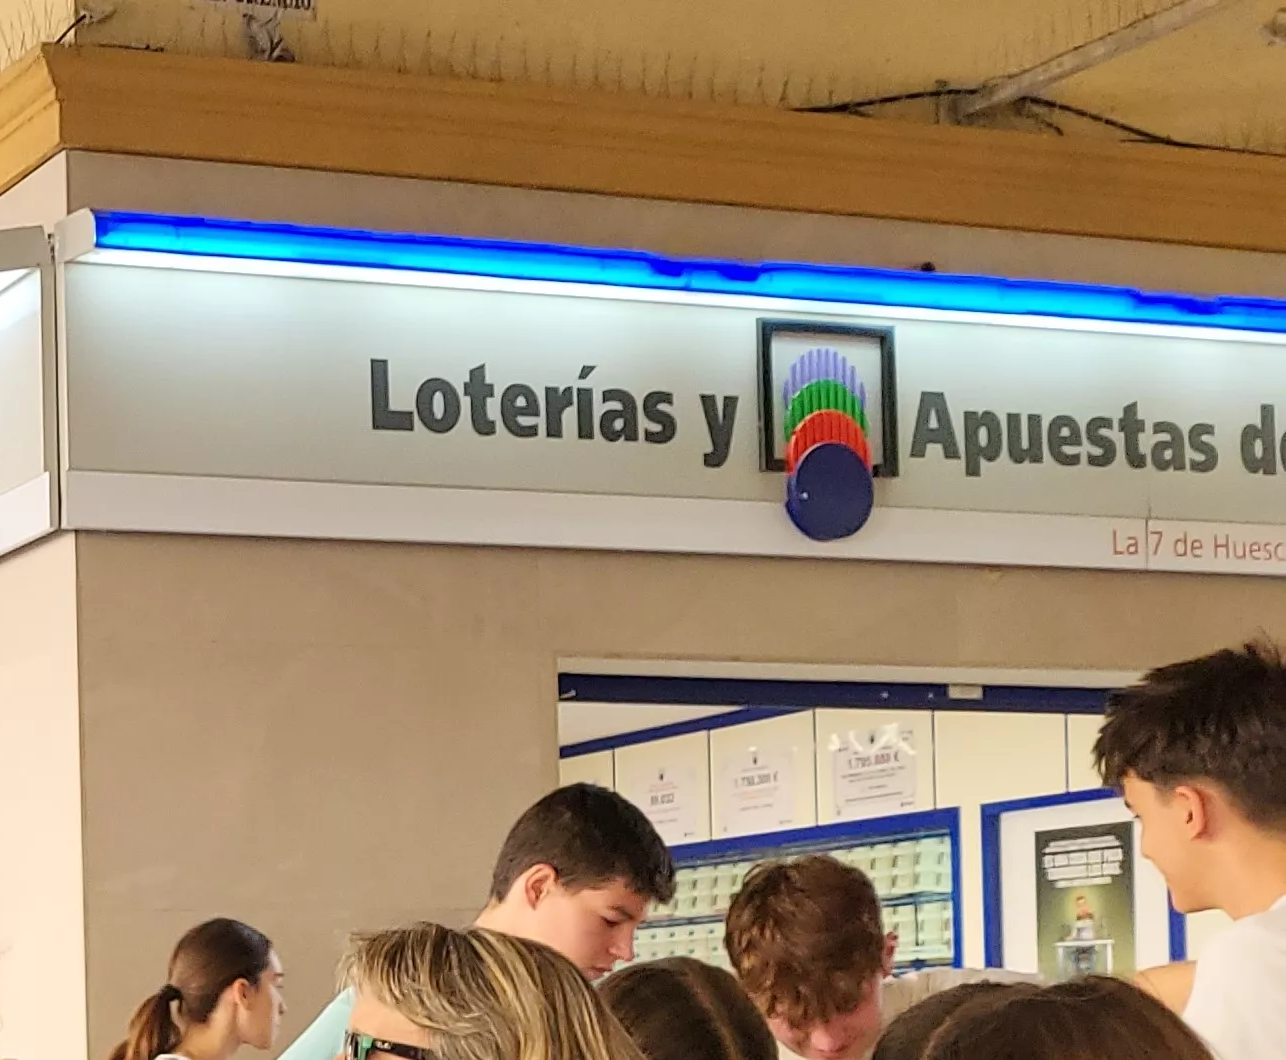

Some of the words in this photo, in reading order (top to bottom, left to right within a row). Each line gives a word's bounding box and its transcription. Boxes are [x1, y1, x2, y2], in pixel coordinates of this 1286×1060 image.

[370, 358, 677, 444] Loterías
[699, 393, 739, 468] y
[909, 390, 1219, 477] Apuestas
[1112, 529, 1138, 556] La
[1150, 531, 1164, 556] 7
[1173, 532, 1203, 558] de
[1213, 534, 1286, 561] Huesc
